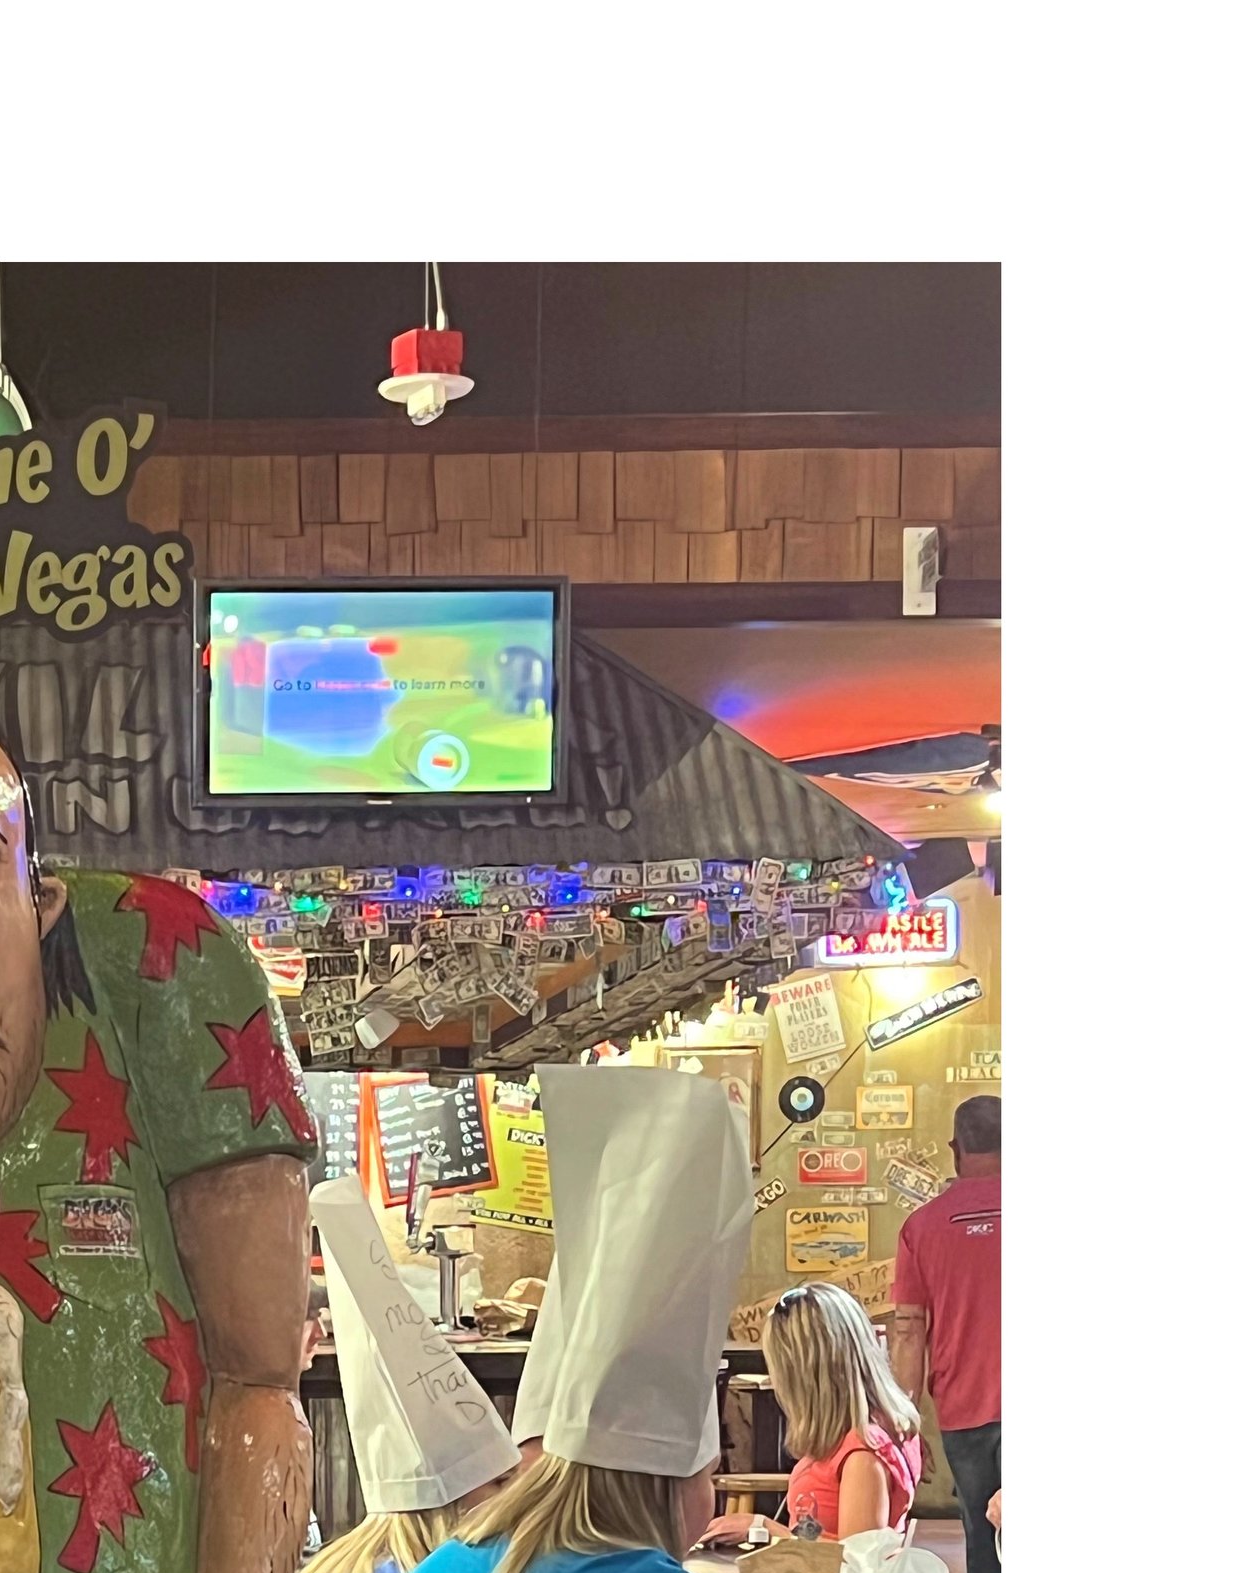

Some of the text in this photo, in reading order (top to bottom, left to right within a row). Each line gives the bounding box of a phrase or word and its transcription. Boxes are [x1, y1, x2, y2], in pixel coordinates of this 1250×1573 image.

[273, 680, 292, 691] Go
[297, 680, 312, 691] to
[393, 679, 408, 690] to
[411, 679, 445, 690] learn
[450, 679, 485, 690] more
[770, 979, 831, 1006] BEWARE
[801, 1150, 863, 1172] OREO
[789, 1210, 866, 1225] CARWASH
